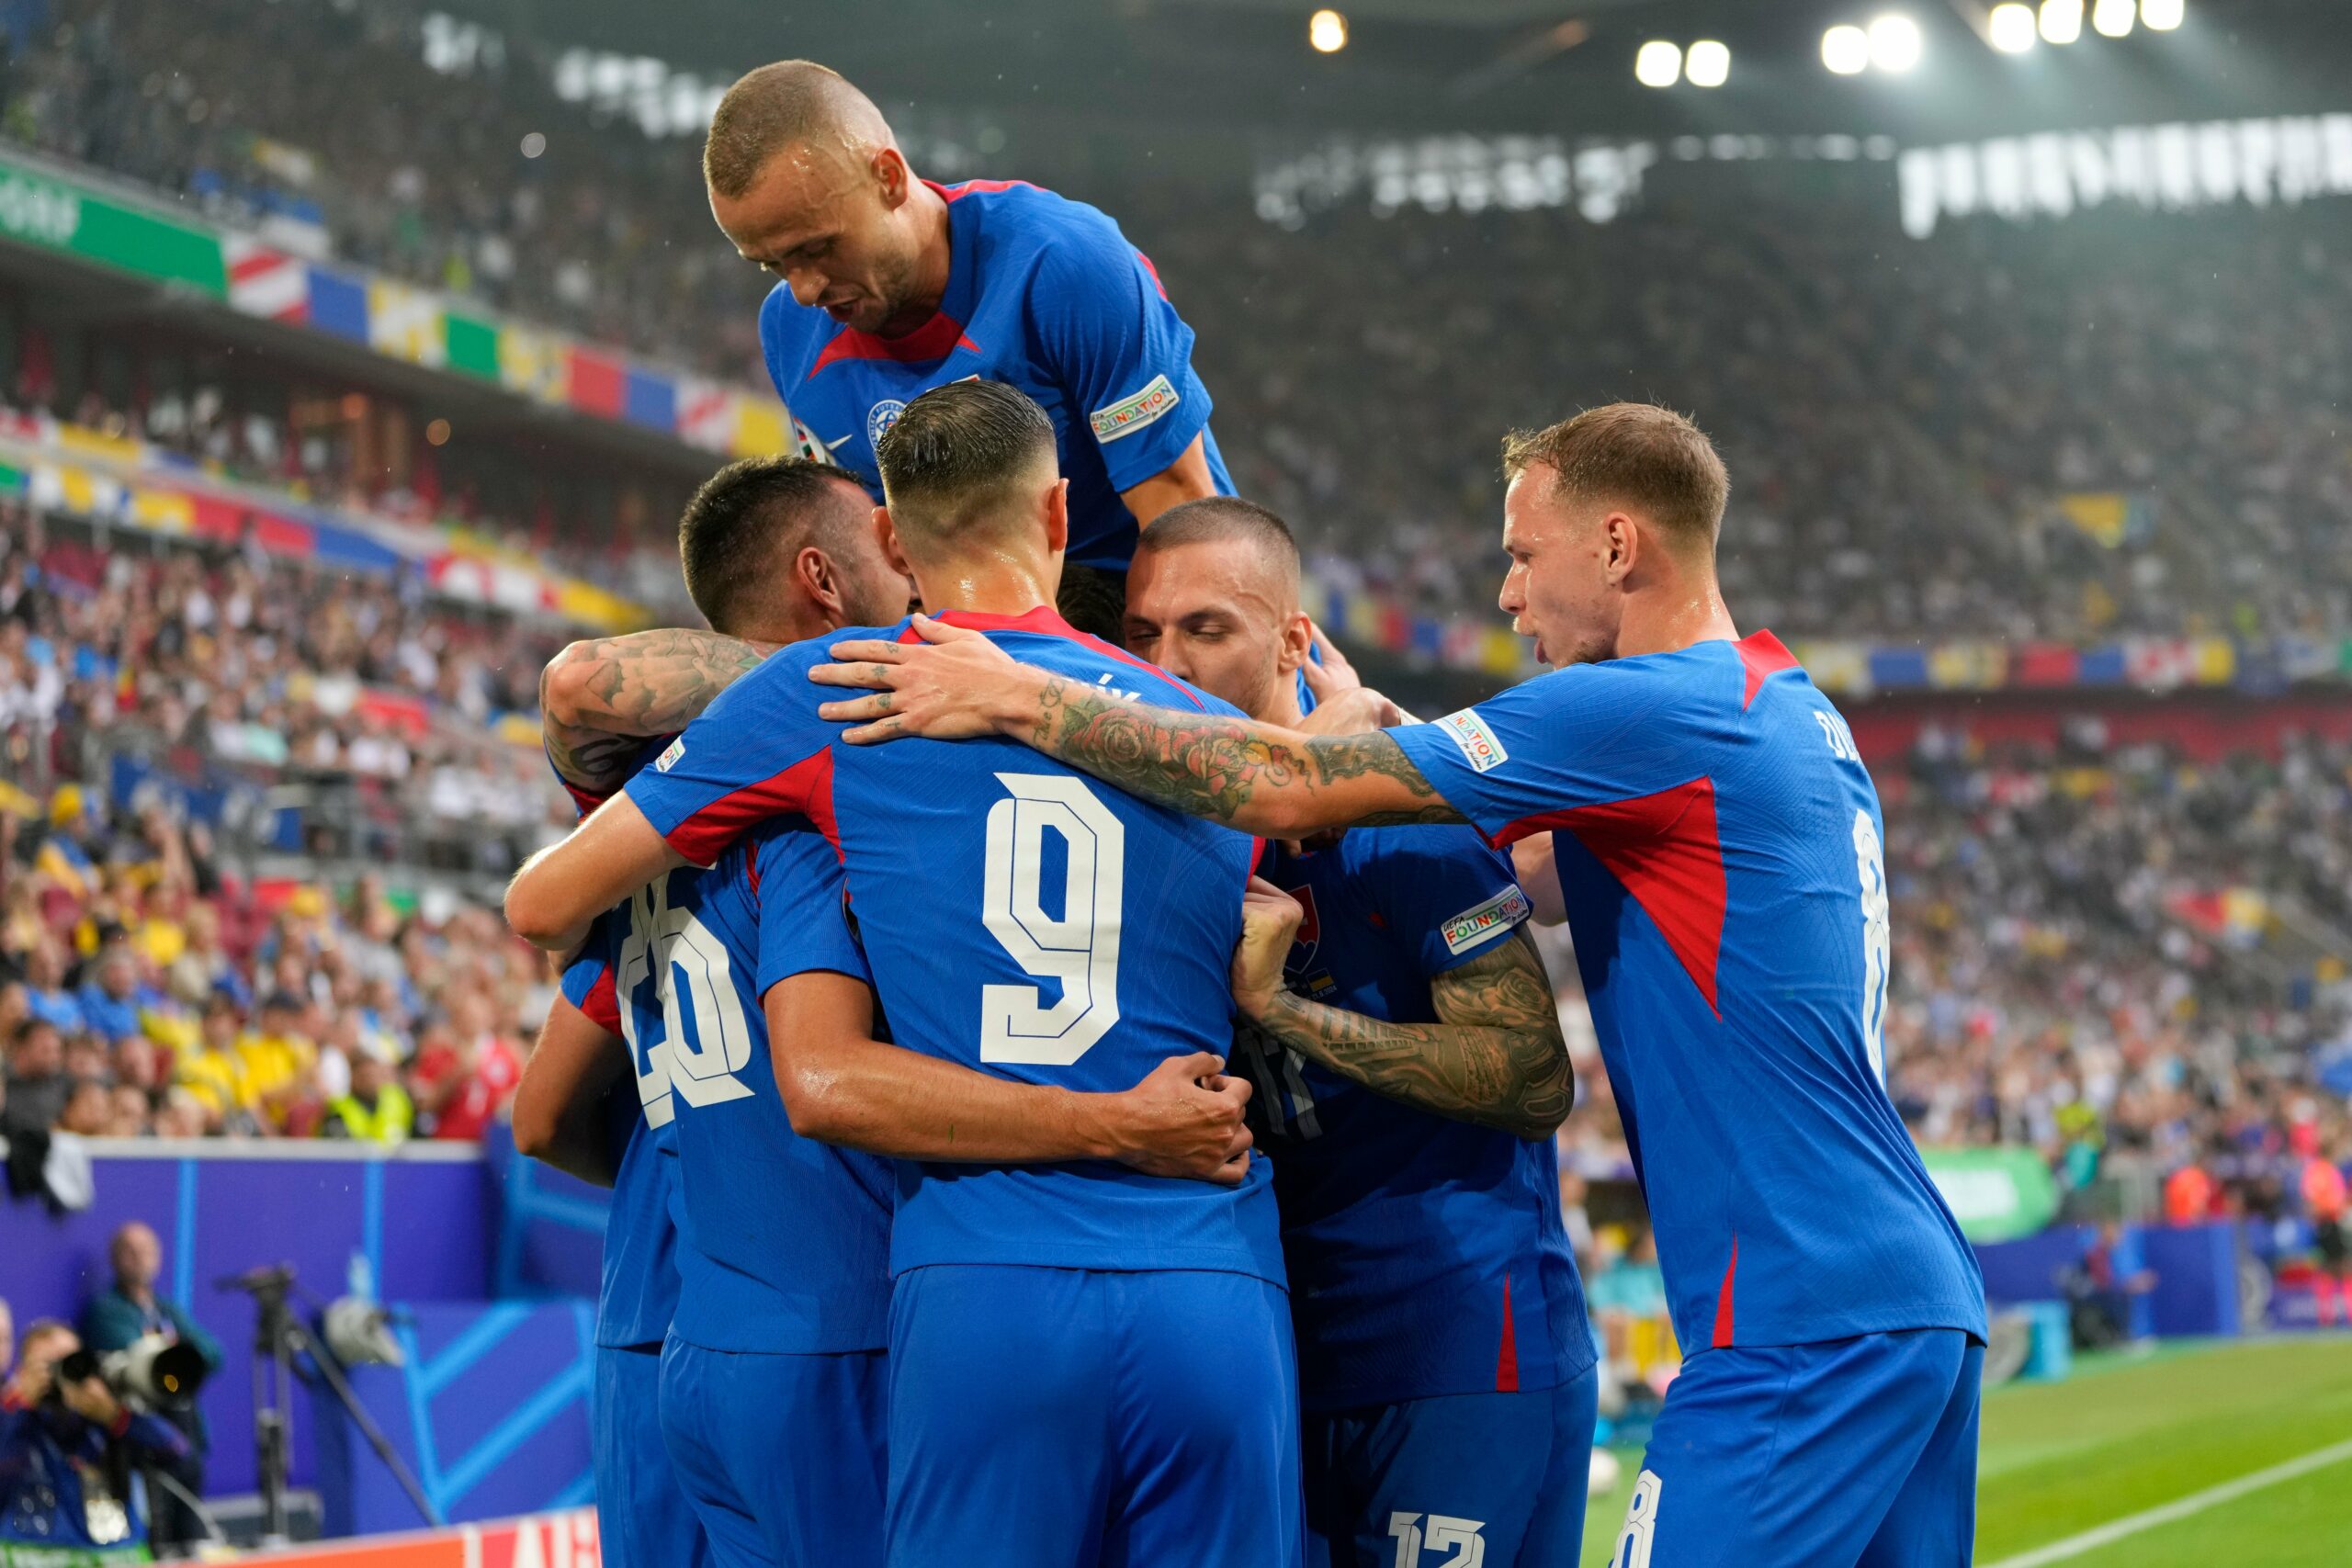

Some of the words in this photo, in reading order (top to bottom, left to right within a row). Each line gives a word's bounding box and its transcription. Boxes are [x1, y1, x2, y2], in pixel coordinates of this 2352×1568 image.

[1092, 385, 1171, 433] FOUNDATION
[1451, 713, 1498, 766] UNDATION
[1813, 711, 1861, 764] DU
[980, 773, 1124, 1066] 9
[1443, 915, 1465, 932] UEFA
[1446, 895, 1524, 943] FOUNDATION
[1852, 808, 1890, 1091] 8
[1610, 1469, 1662, 1568] 8
